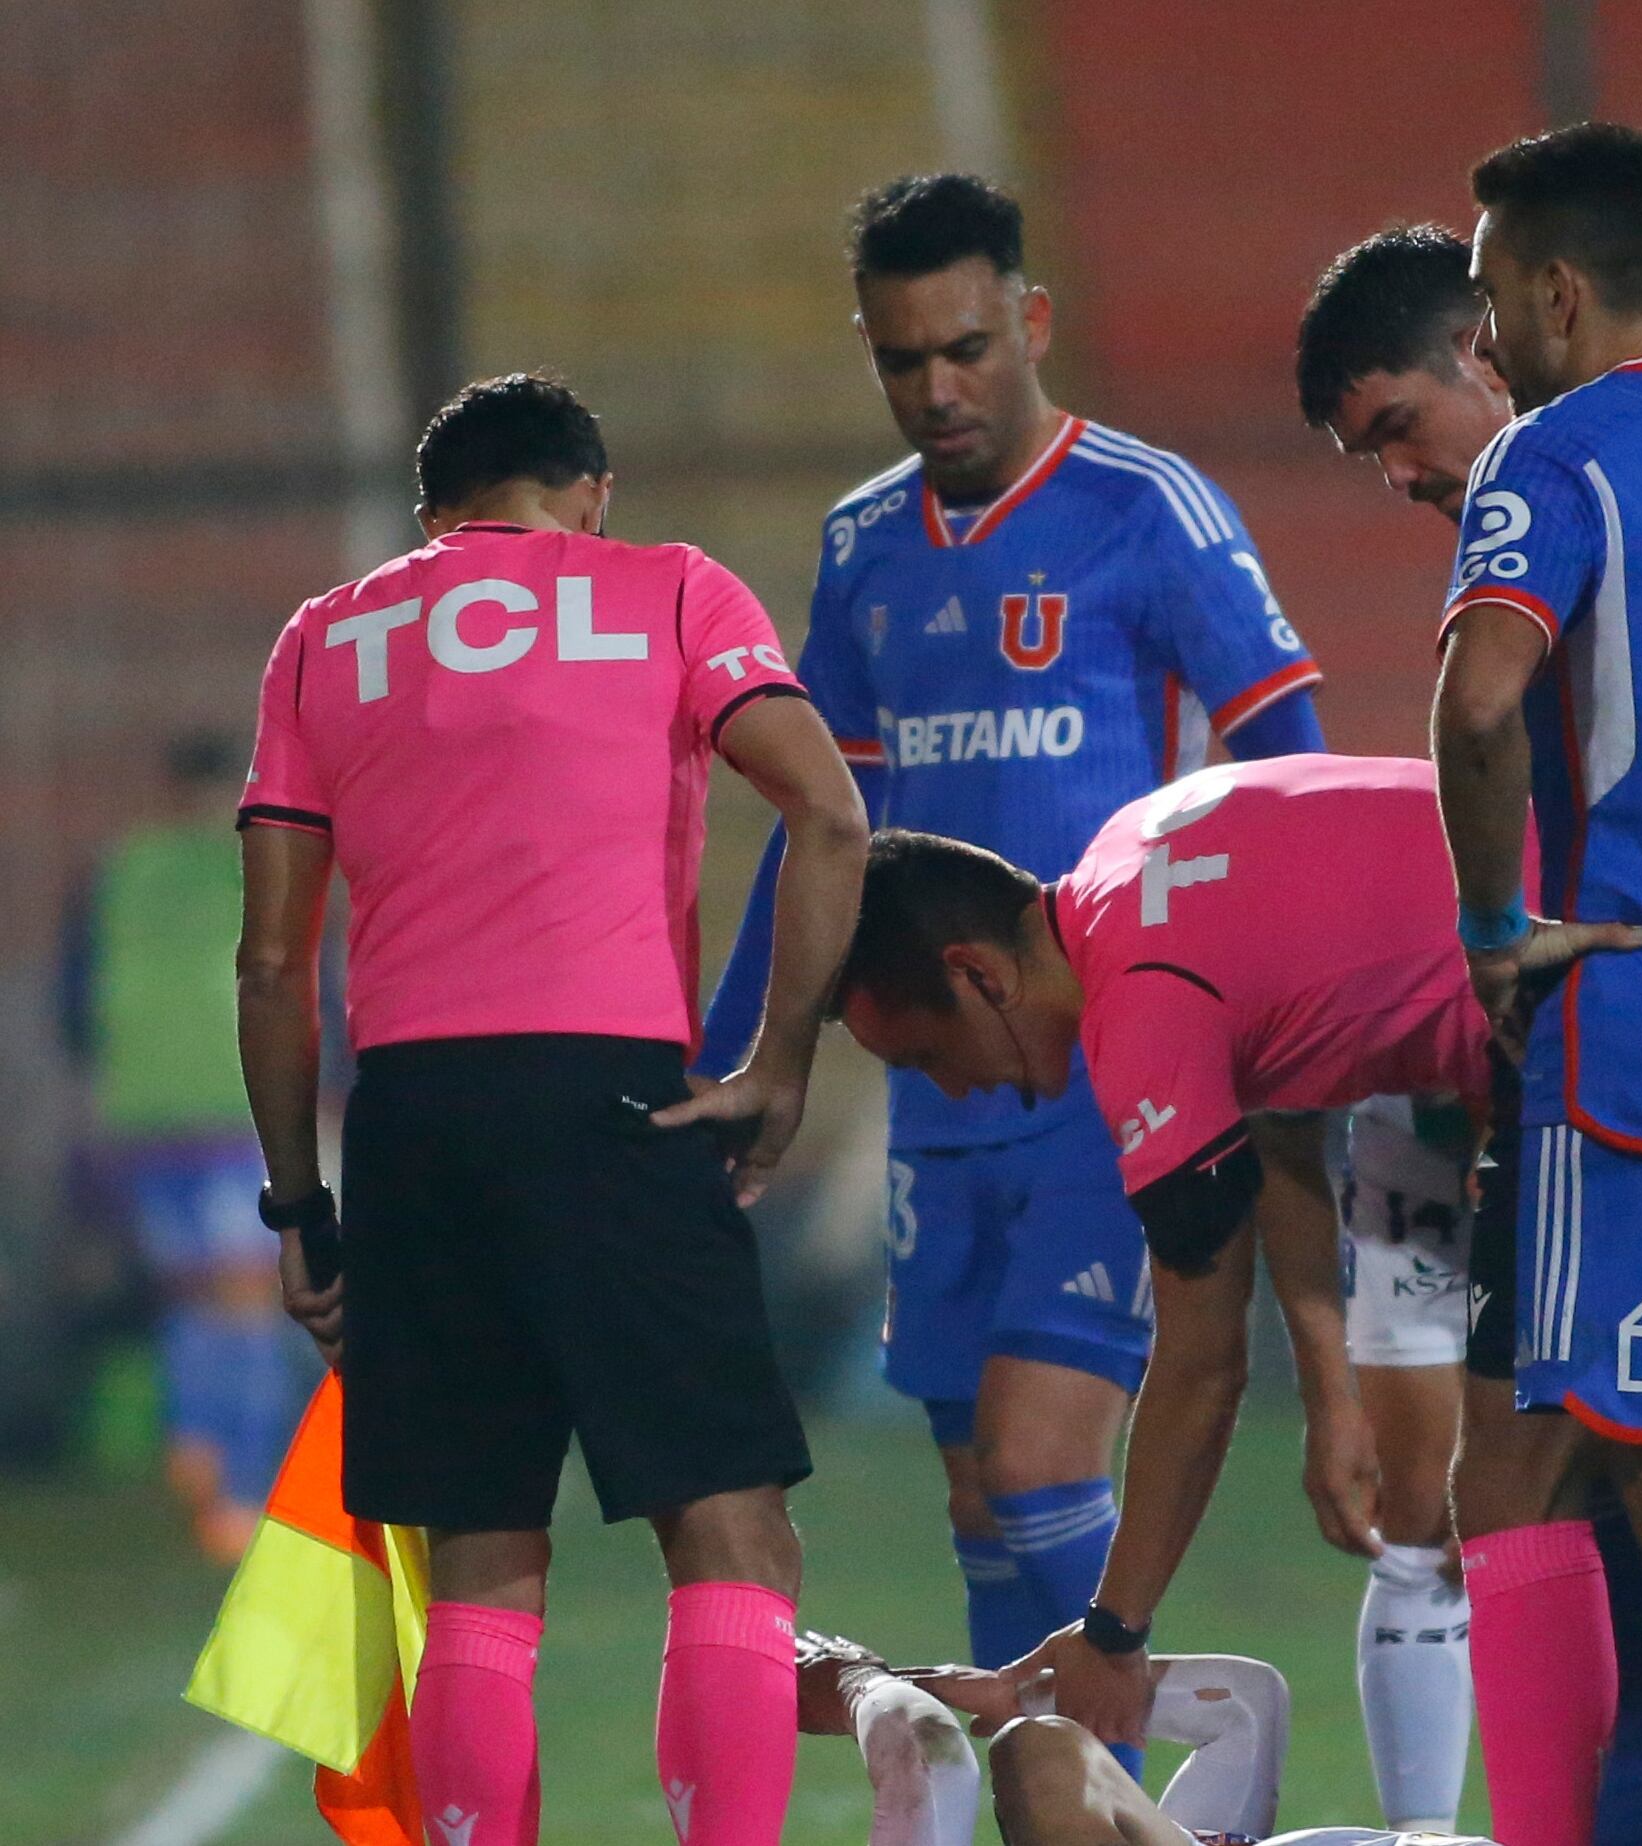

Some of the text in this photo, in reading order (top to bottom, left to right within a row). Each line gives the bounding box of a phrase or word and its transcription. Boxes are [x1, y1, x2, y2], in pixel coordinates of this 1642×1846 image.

[1458, 551, 1529, 585] GO
[325, 576, 649, 703] TCL
[707, 647, 793, 681] TC
[900, 705, 1084, 767] BETANO
[1120, 1097, 1177, 1155] CL
